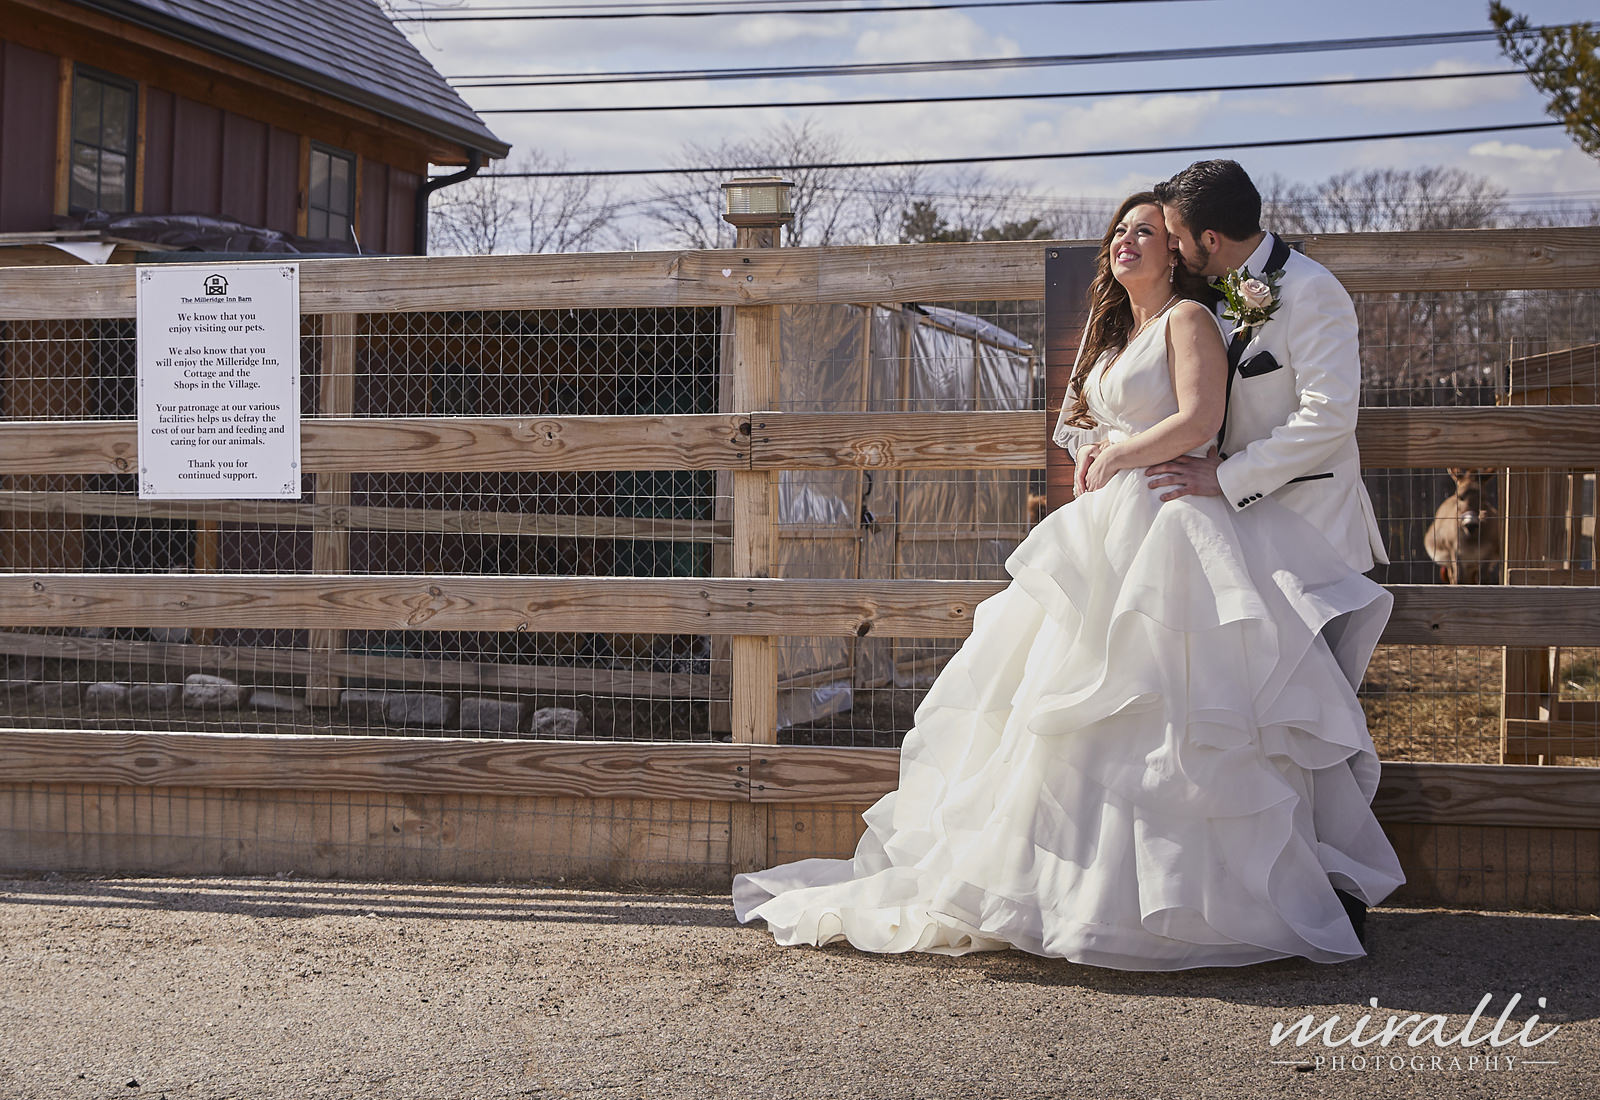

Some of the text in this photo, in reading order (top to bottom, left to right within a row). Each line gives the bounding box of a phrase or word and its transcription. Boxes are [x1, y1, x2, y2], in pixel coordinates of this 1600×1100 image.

[180, 296, 193, 304] The
[193, 296, 226, 304] Milleridge
[237, 295, 253, 303] Barn
[177, 311, 256, 323] We know that you
[168, 324, 193, 335] enjoy
[193, 323, 227, 334] visiting
[244, 324, 265, 334] pets.
[168, 345, 266, 357] We also know that you
[155, 357, 280, 369] will enjoy the Milleridge Inn,
[183, 368, 251, 380] Cottage and the
[173, 379, 261, 392] Shops in the Village.
[155, 402, 281, 414] Your patronage at our various
[159, 414, 196, 424] facilities
[196, 414, 220, 425] helps
[233, 414, 260, 425] defray
[262, 413, 277, 423] the
[151, 424, 285, 436] cost of our barn and feeding and
[170, 436, 266, 447] caring for our animals.
[187, 458, 249, 470] Thank you for
[177, 470, 258, 482] continued support.
